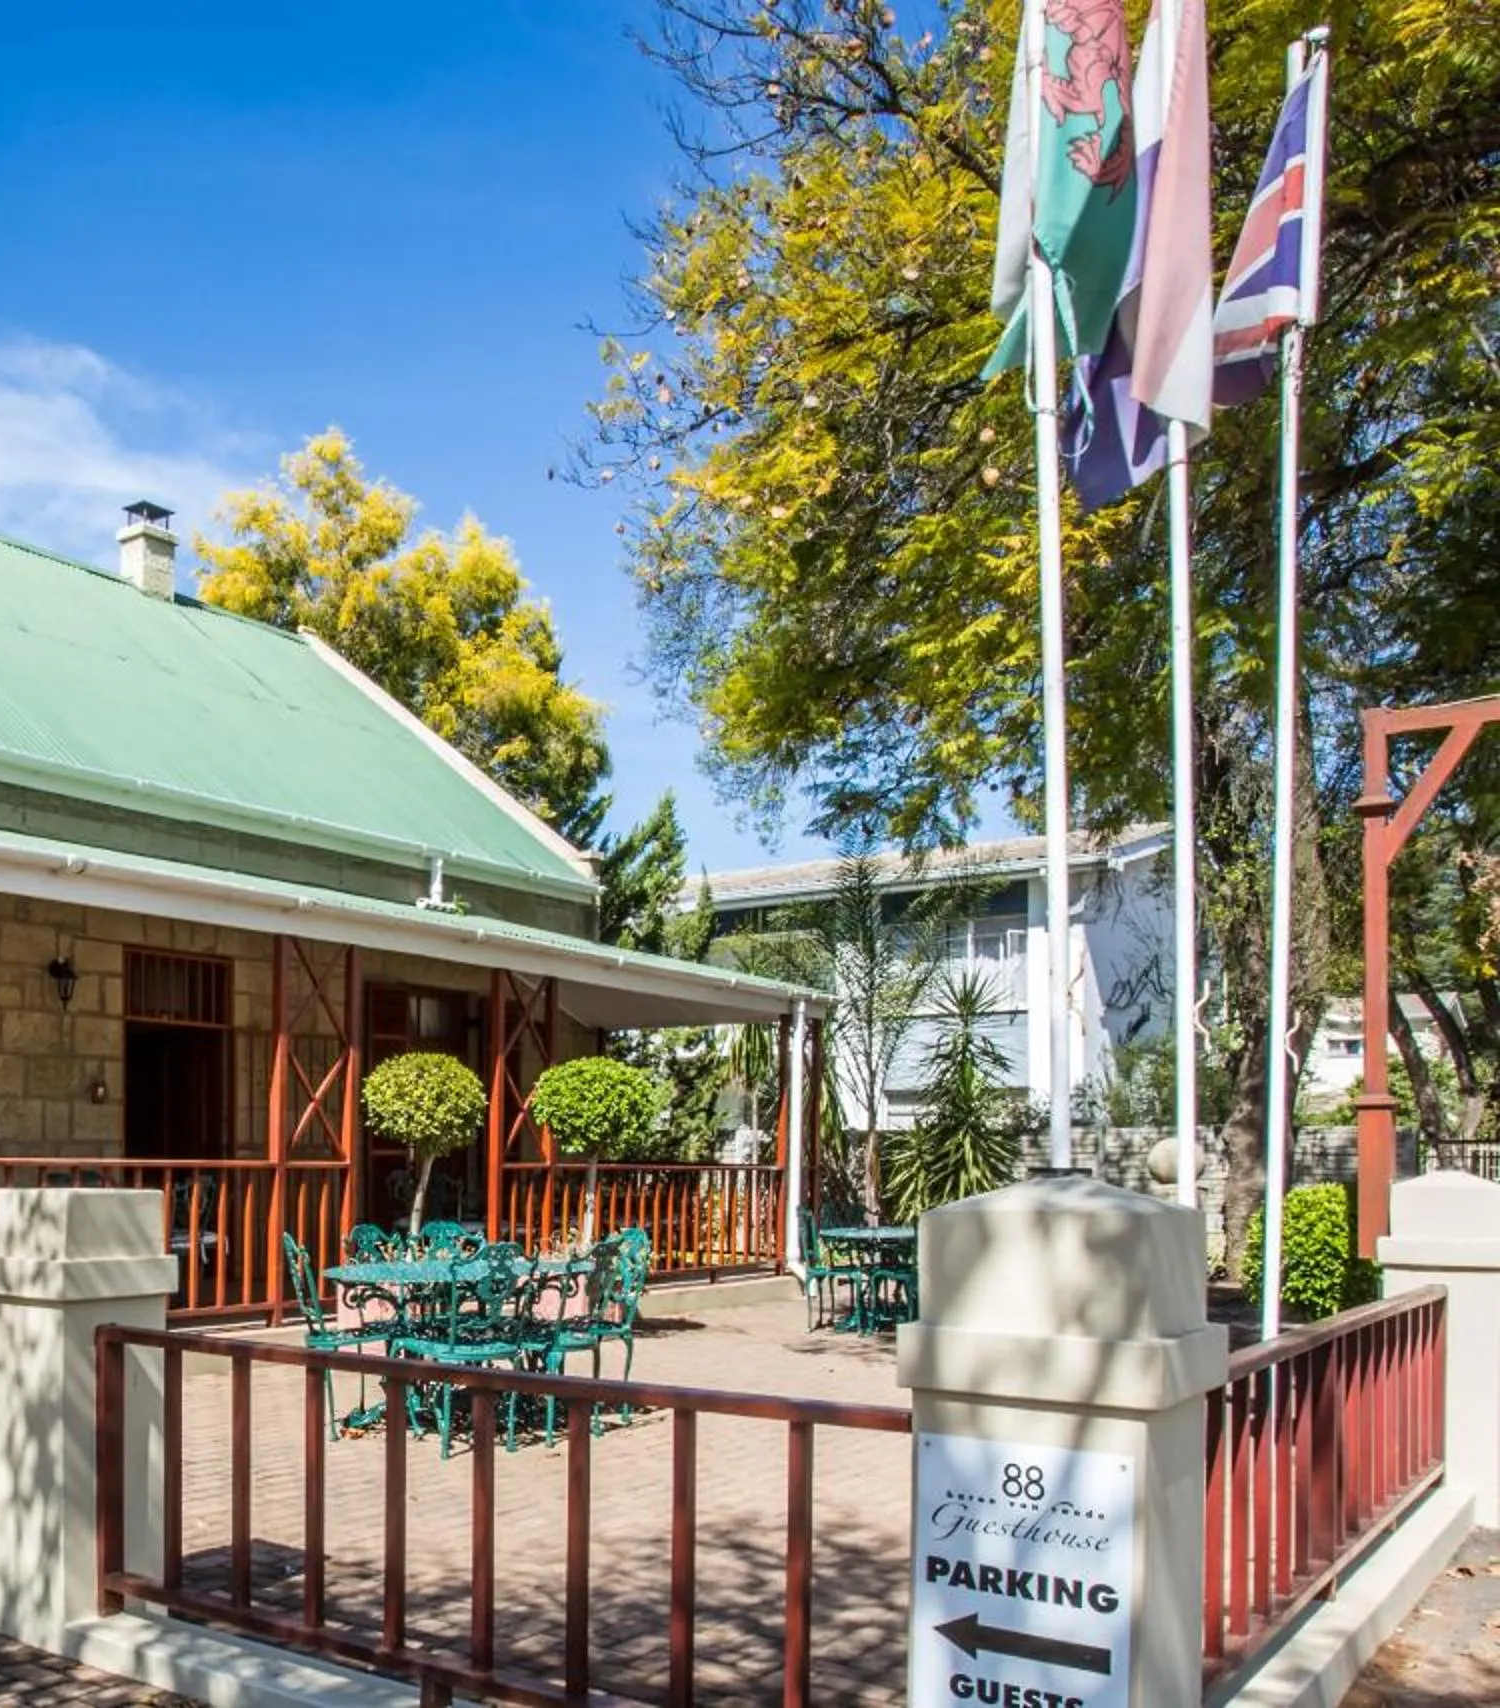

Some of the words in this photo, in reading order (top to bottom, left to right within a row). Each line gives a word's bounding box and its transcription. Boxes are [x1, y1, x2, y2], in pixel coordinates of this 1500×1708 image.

[1002, 1463, 1045, 1501] 88
[931, 1502, 1110, 1552] Guesthouse
[926, 1555, 1119, 1614] PARKING
